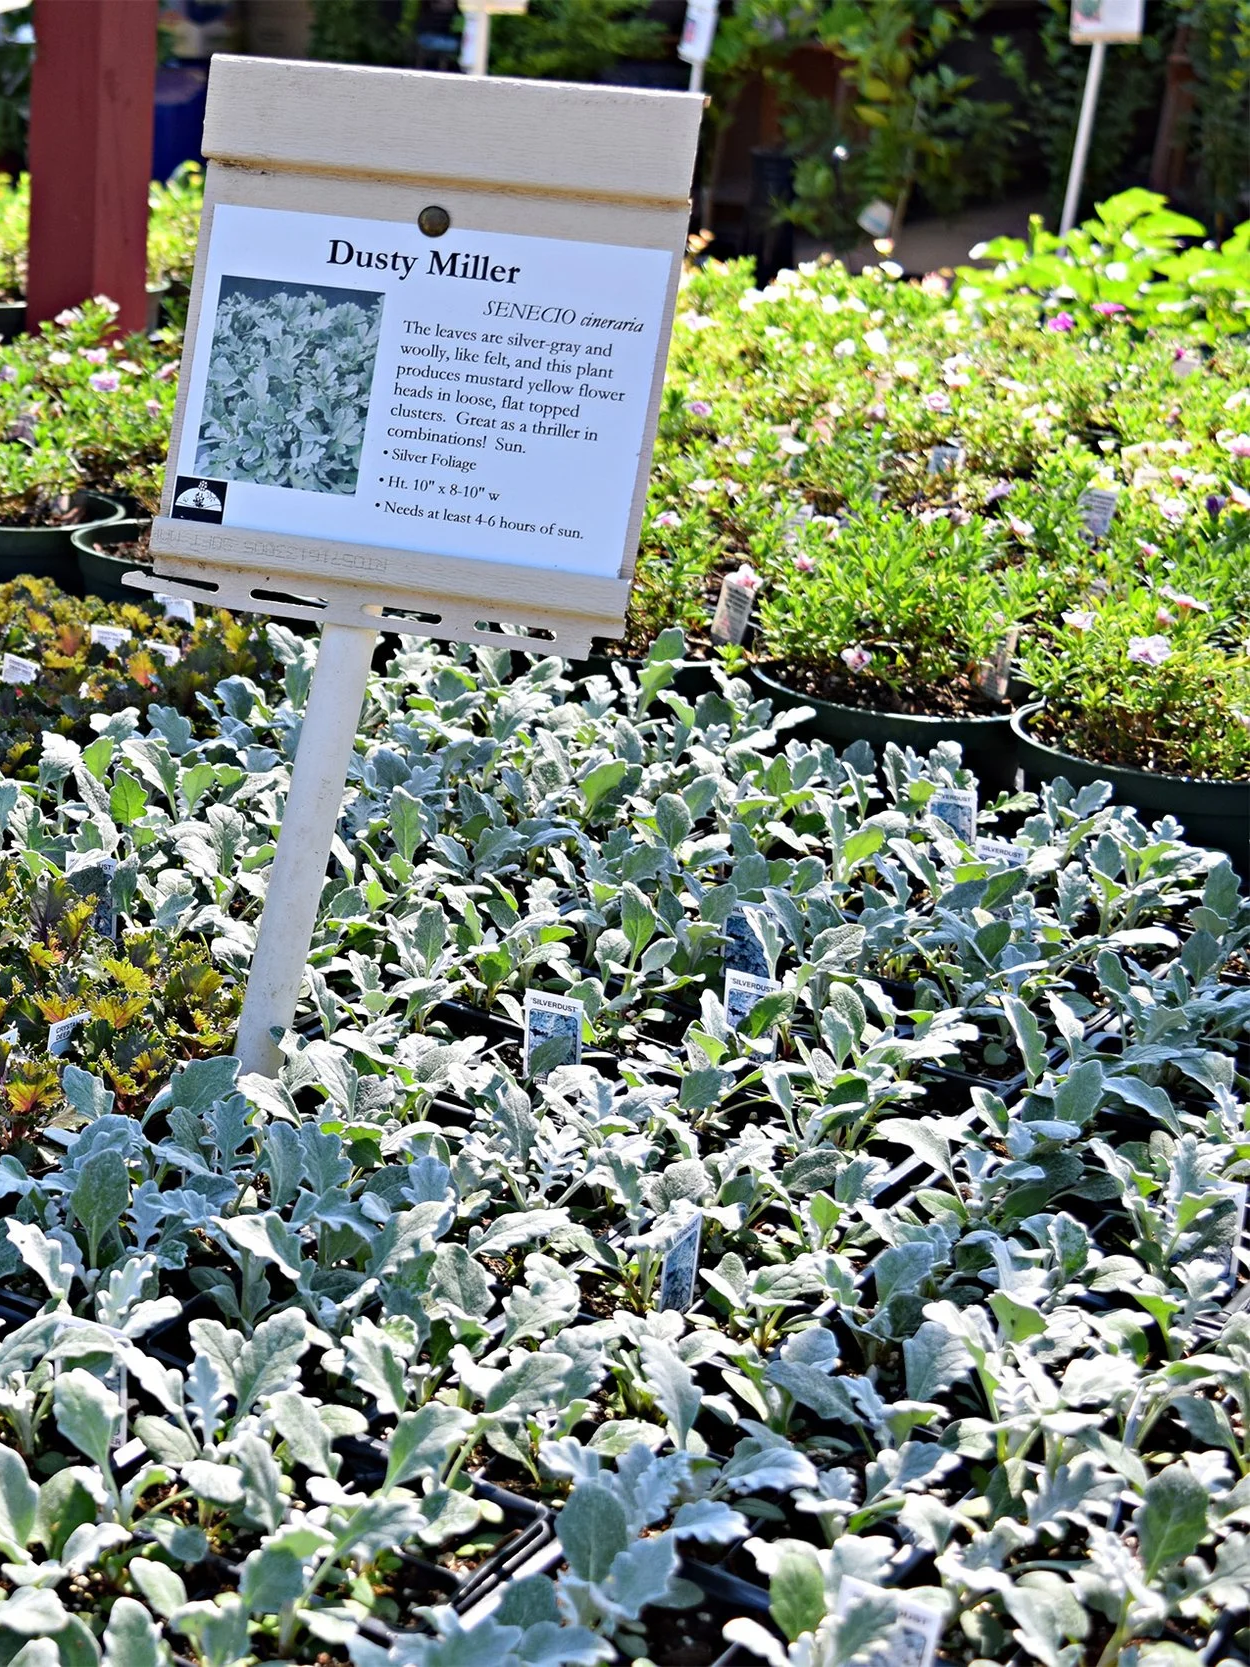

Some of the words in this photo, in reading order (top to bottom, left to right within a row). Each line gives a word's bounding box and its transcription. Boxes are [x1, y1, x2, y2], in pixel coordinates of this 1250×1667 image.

[326, 239, 419, 280] Dusty
[426, 250, 521, 284] Miller
[483, 300, 576, 325] SENECIO
[579, 313, 644, 333] cineraria
[403, 320, 431, 336] The
[435, 324, 477, 342] leaves
[481, 333, 503, 344] are
[507, 333, 581, 357] silver-gray
[585, 343, 612, 357] and
[400, 344, 450, 362] woolly,
[454, 347, 480, 363] like
[484, 351, 510, 369] felt,
[515, 357, 541, 371] and
[546, 359, 572, 374] this
[576, 362, 614, 379] plant
[394, 382, 433, 400] heads
[438, 386, 451, 402] in
[456, 390, 496, 410] loose,
[501, 395, 525, 411] flat
[529, 400, 580, 419] topped
[396, 364, 460, 382] produces
[465, 372, 523, 390] mustard
[528, 379, 574, 396] yellow
[579, 383, 626, 402] flower
[387, 424, 487, 449] combinations!
[495, 437, 526, 454] Sun.
[390, 403, 446, 422] clusters.
[456, 411, 496, 429] Great
[500, 420, 515, 431] as
[519, 423, 527, 432] a
[532, 420, 581, 440] thriller
[584, 428, 598, 442] in
[391, 448, 428, 465] Silver
[431, 453, 477, 473] Foliage
[388, 476, 408, 490] Ht.
[413, 479, 435, 492] 10"
[438, 485, 446, 494] x
[450, 483, 485, 499] 8-10"
[488, 492, 500, 501] w
[384, 501, 424, 518] Needs
[427, 509, 440, 519] at
[444, 509, 471, 524] least
[475, 513, 496, 527] 4-6
[500, 516, 536, 533] hours
[540, 523, 556, 536] of
[558, 528, 584, 539] sun.
[56, 1019, 82, 1033] CRYSTA
